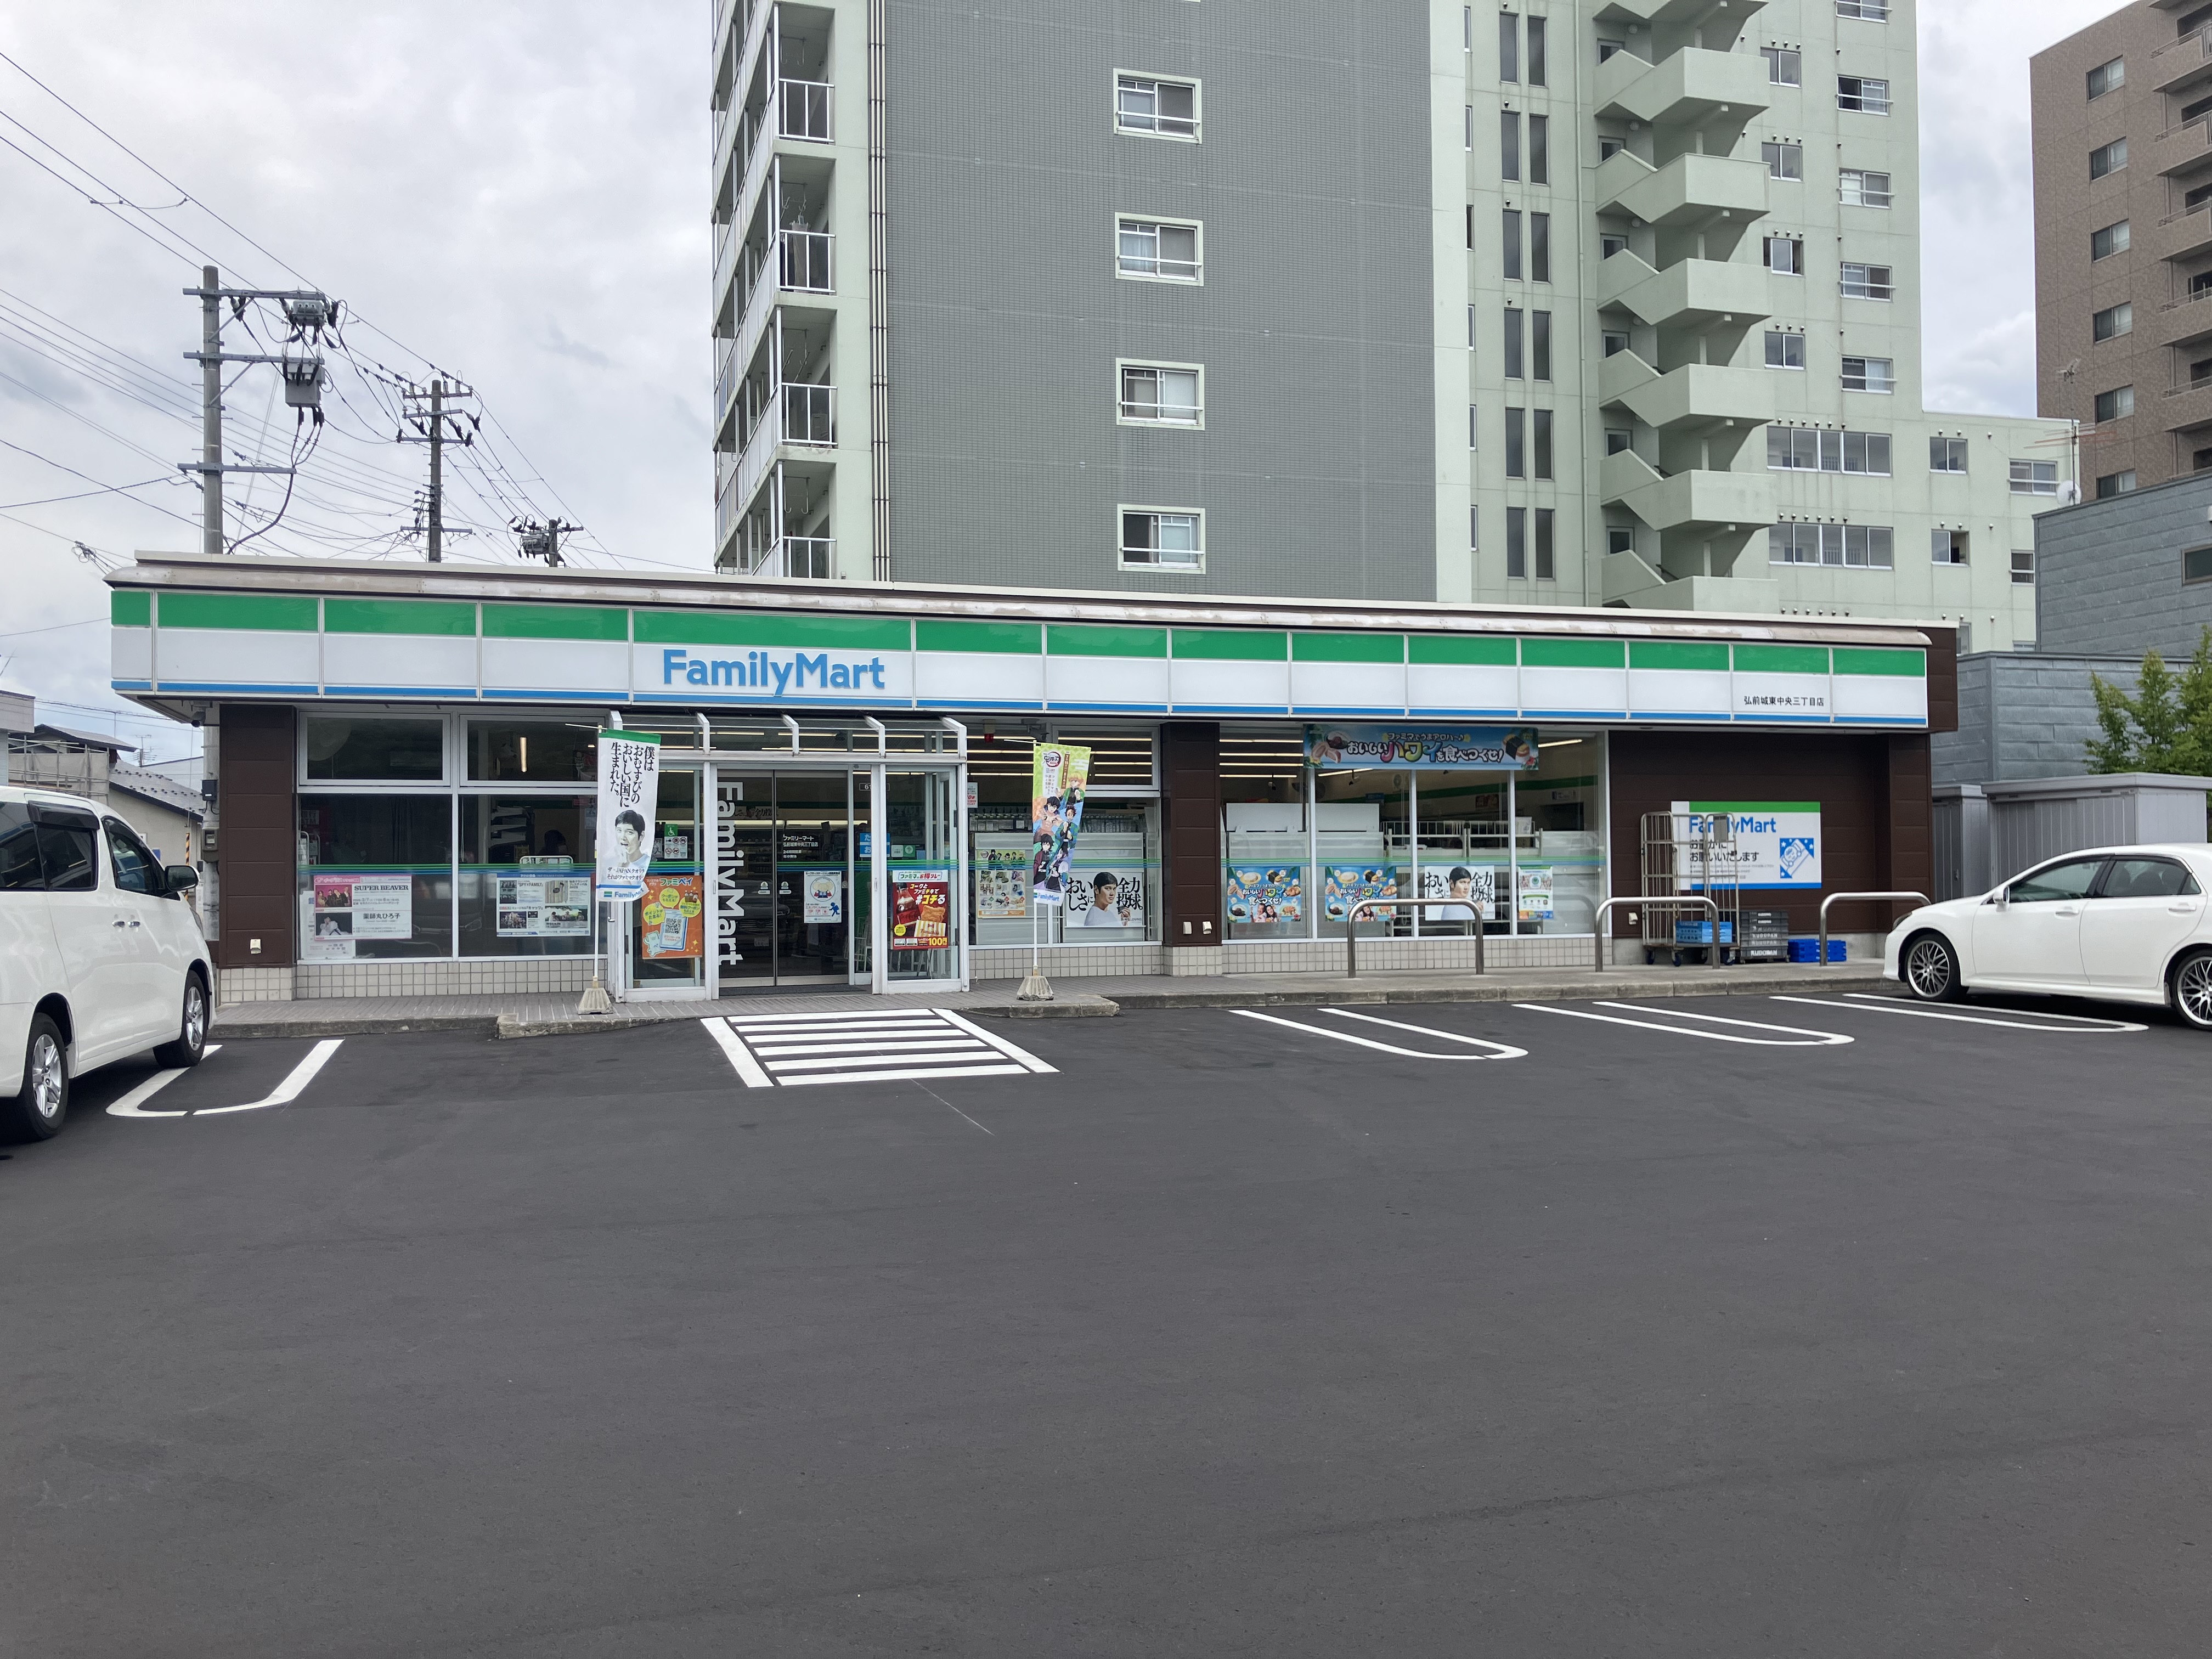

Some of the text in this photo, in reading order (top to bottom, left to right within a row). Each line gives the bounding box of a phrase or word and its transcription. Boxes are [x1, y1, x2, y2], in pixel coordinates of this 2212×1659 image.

[663, 649, 885, 697] FamilyMart
[1743, 696, 1824, 707] 弘前城東中央三丁目店
[644, 746, 655, 771] 僕は
[610, 742, 622, 795] 生まれた。
[619, 743, 633, 808] おいしい国に
[631, 744, 644, 804] おむすびの
[1689, 816, 1776, 834] FalyMart
[659, 877, 693, 886] ファミペイ
[718, 782, 744, 966] FamilyMart
[1425, 872, 1449, 888] おい
[1471, 871, 1492, 887] 全力
[1066, 877, 1093, 894] おい
[1117, 877, 1141, 893] 全力
[915, 894, 946, 905] #コチる
[1037, 893, 1059, 901] FamilyMart
[1068, 894, 1095, 911] しさに
